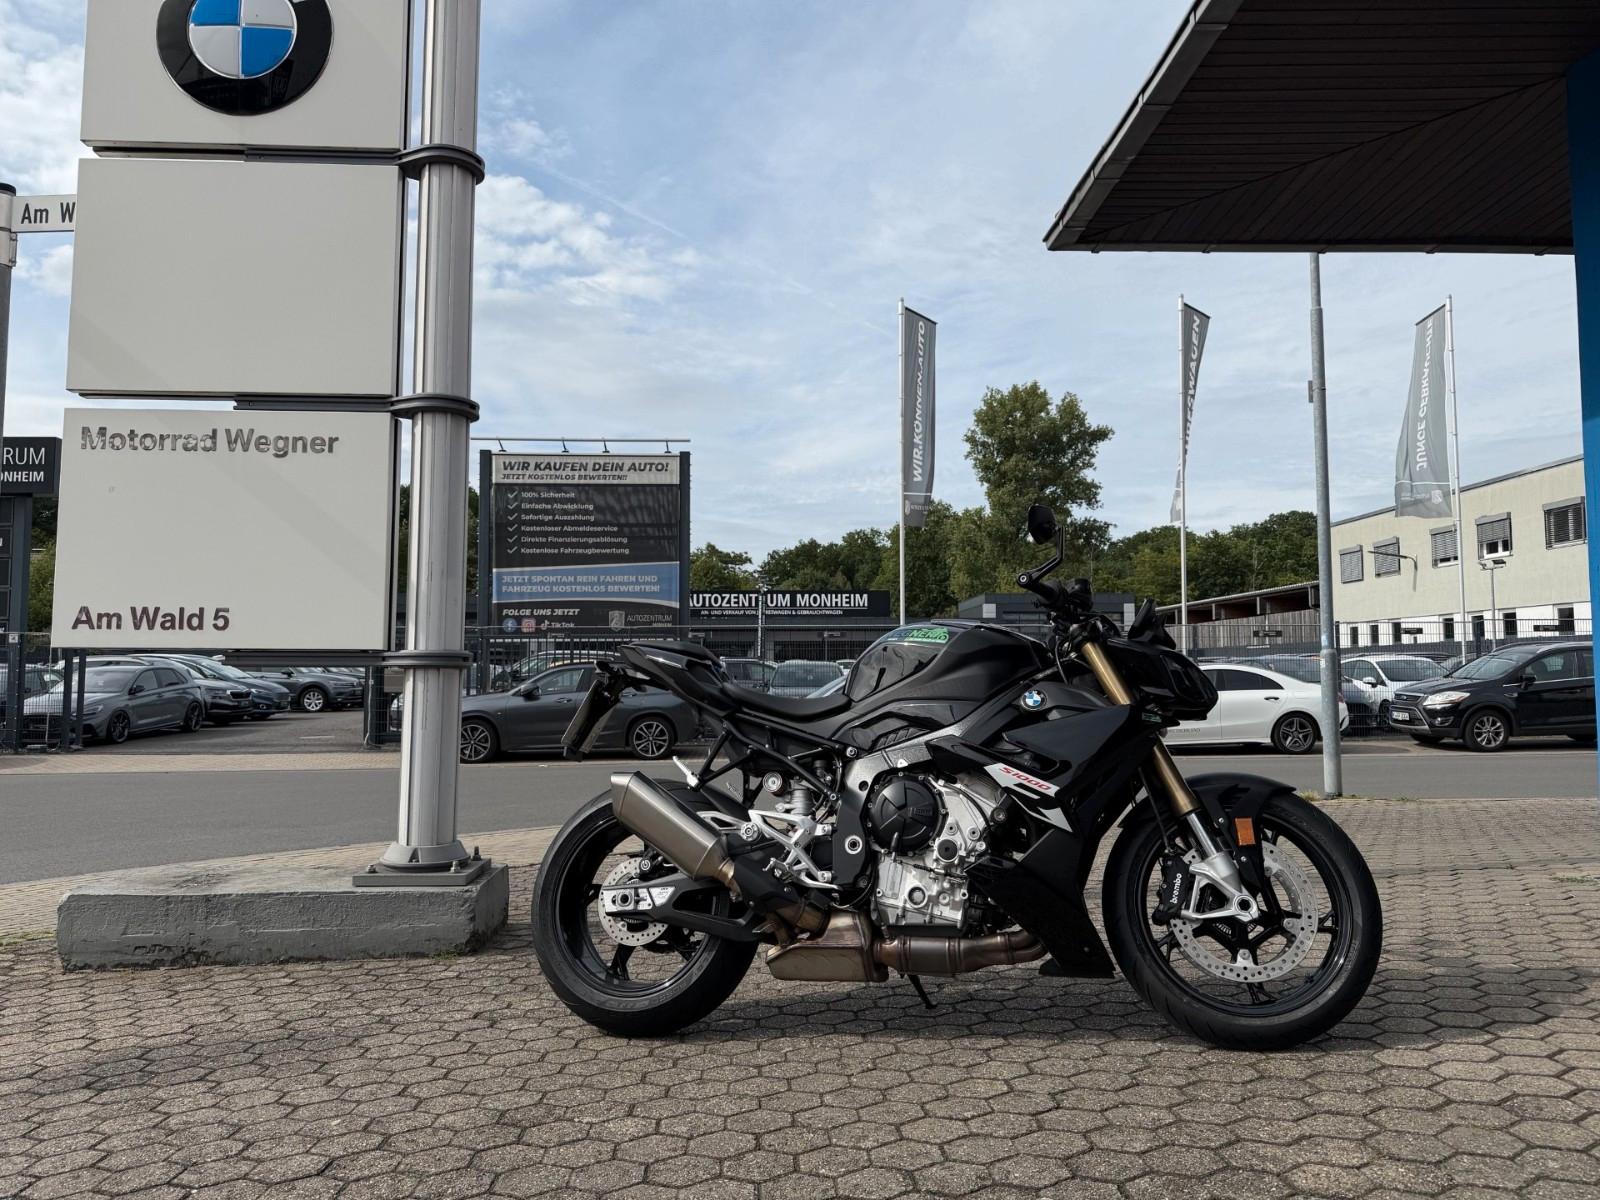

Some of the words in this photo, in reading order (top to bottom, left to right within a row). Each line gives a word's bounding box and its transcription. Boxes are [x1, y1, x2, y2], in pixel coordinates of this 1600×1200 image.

[21, 203, 49, 224] Am
[60, 202, 76, 223] W
[81, 426, 217, 452] Motorrad
[225, 428, 339, 458] Wegner
[3, 447, 45, 465] RUM
[502, 461, 531, 471] WIR
[533, 461, 588, 472] KAUFEN
[592, 462, 625, 472] DEIN
[627, 462, 670, 472] AUTO!
[1, 471, 45, 482] NHEIM
[552, 503, 594, 511] Abwicklung
[548, 536, 628, 544] Finanzierungsablösung
[560, 547, 630, 555] Fahrzeugbewertung
[502, 575, 529, 583] JETZT
[531, 575, 575, 583] SPONTAN
[600, 575, 636, 583] FAHREN
[639, 575, 658, 583] UND
[502, 585, 551, 593] FAHRZEUG
[552, 585, 606, 593] KOSTENLOS
[689, 593, 791, 607] UTOZENTUM
[796, 593, 869, 607] MONHEIM
[502, 608, 532, 616] FOLGE
[553, 608, 580, 616] JETZT
[71, 605, 122, 630] Am
[130, 606, 205, 631] Wald
[212, 607, 230, 631] 5
[1000, 767, 1052, 791] S1000
[1169, 873, 1183, 904] brembo
